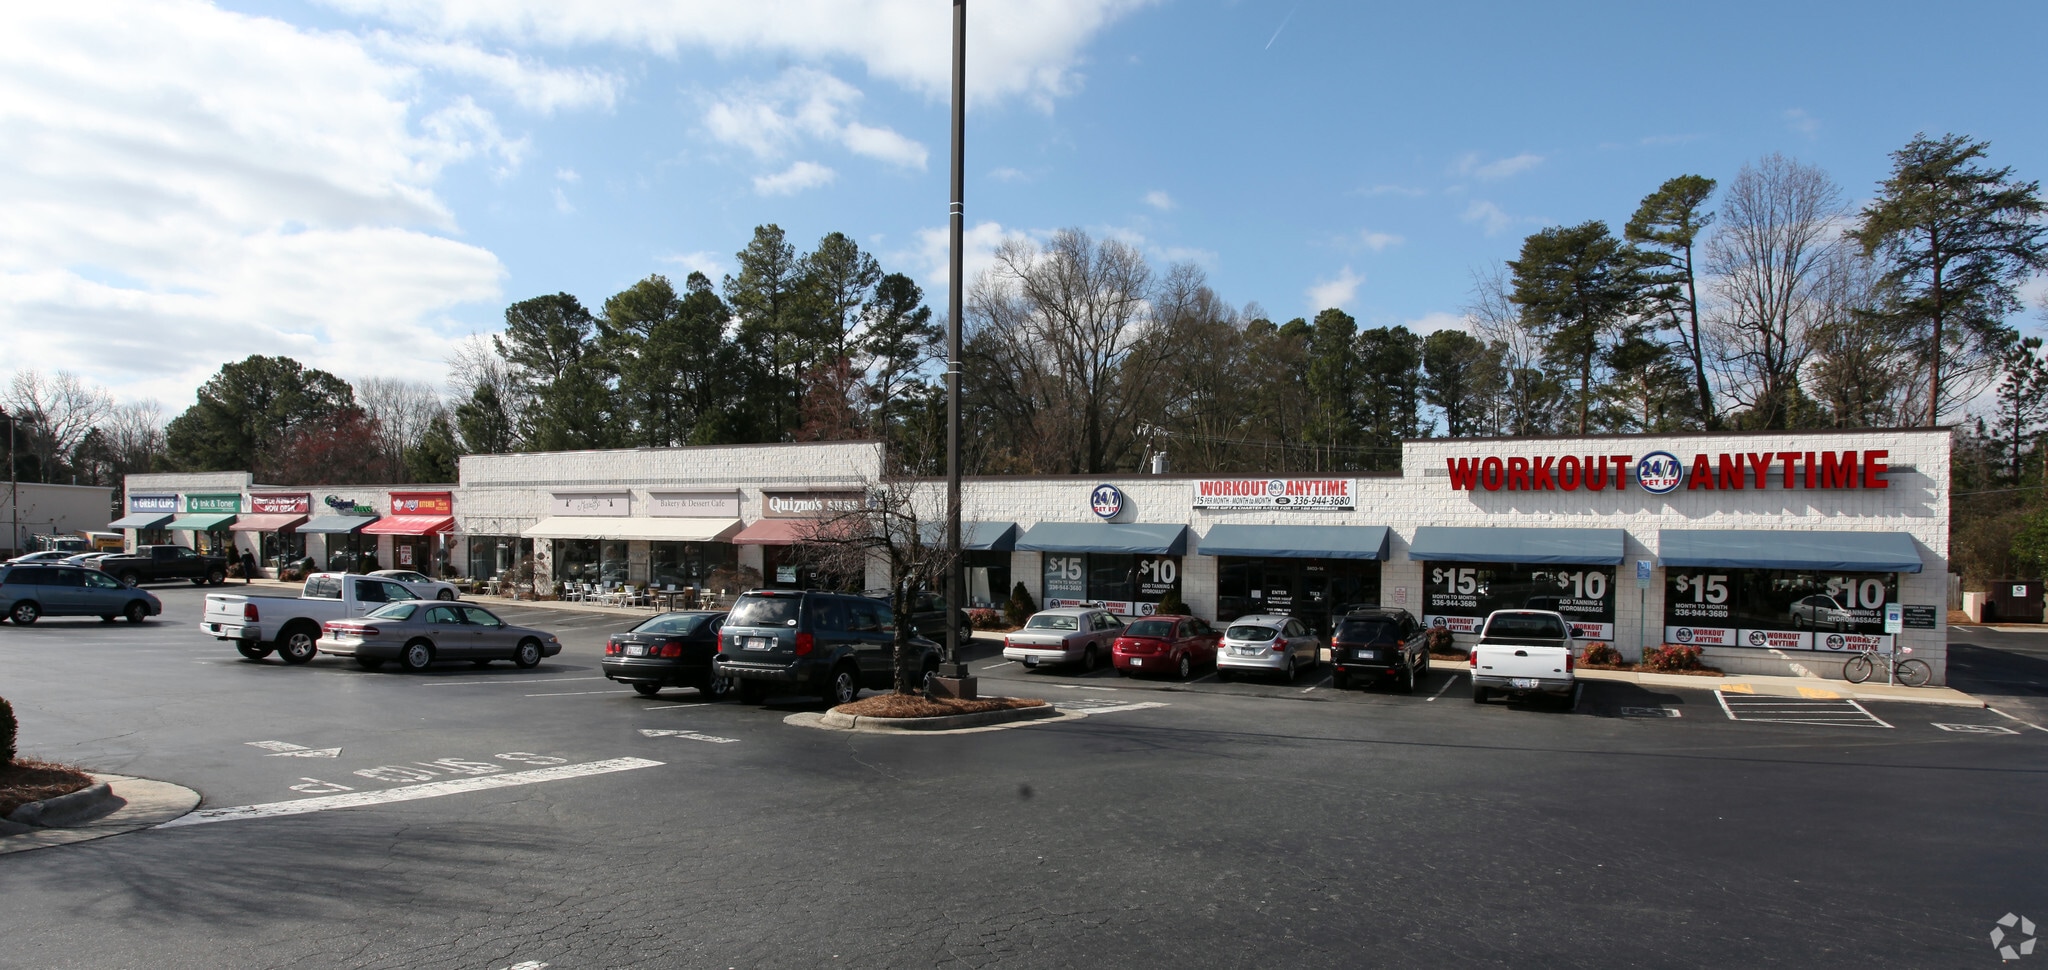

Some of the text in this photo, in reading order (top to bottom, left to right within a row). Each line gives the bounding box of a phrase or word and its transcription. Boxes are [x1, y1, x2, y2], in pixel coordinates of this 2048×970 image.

[1446, 449, 1888, 491] WORKOUT 24/7 ANYTIME
[1200, 481, 1268, 496] WORKOUT
[1285, 481, 1348, 496] ANYTIME
[1641, 478, 1678, 488] GET FIT
[139, 499, 174, 509] GREAT CLIPS
[216, 499, 235, 508] Toner
[660, 500, 680, 508] Bakery
[1093, 490, 1119, 507] 24/7
[1293, 497, 1350, 505] 336-944-3680
[769, 497, 822, 513] Quizno's
[1050, 557, 1082, 581] $15
[1140, 560, 1176, 584] $10
[1432, 567, 1476, 595] $15
[1557, 571, 1606, 600] $10
[1676, 574, 1728, 604] $15
[1825, 578, 1885, 609] $10
[1559, 605, 1603, 613] HYDROMASSAGE
[1675, 609, 1728, 618] 336-944-3680
[1827, 616, 1881, 624] HYDROMASSAGE
[1693, 629, 1725, 637] WORKOUT
[1767, 632, 1801, 640] WORKOUT
